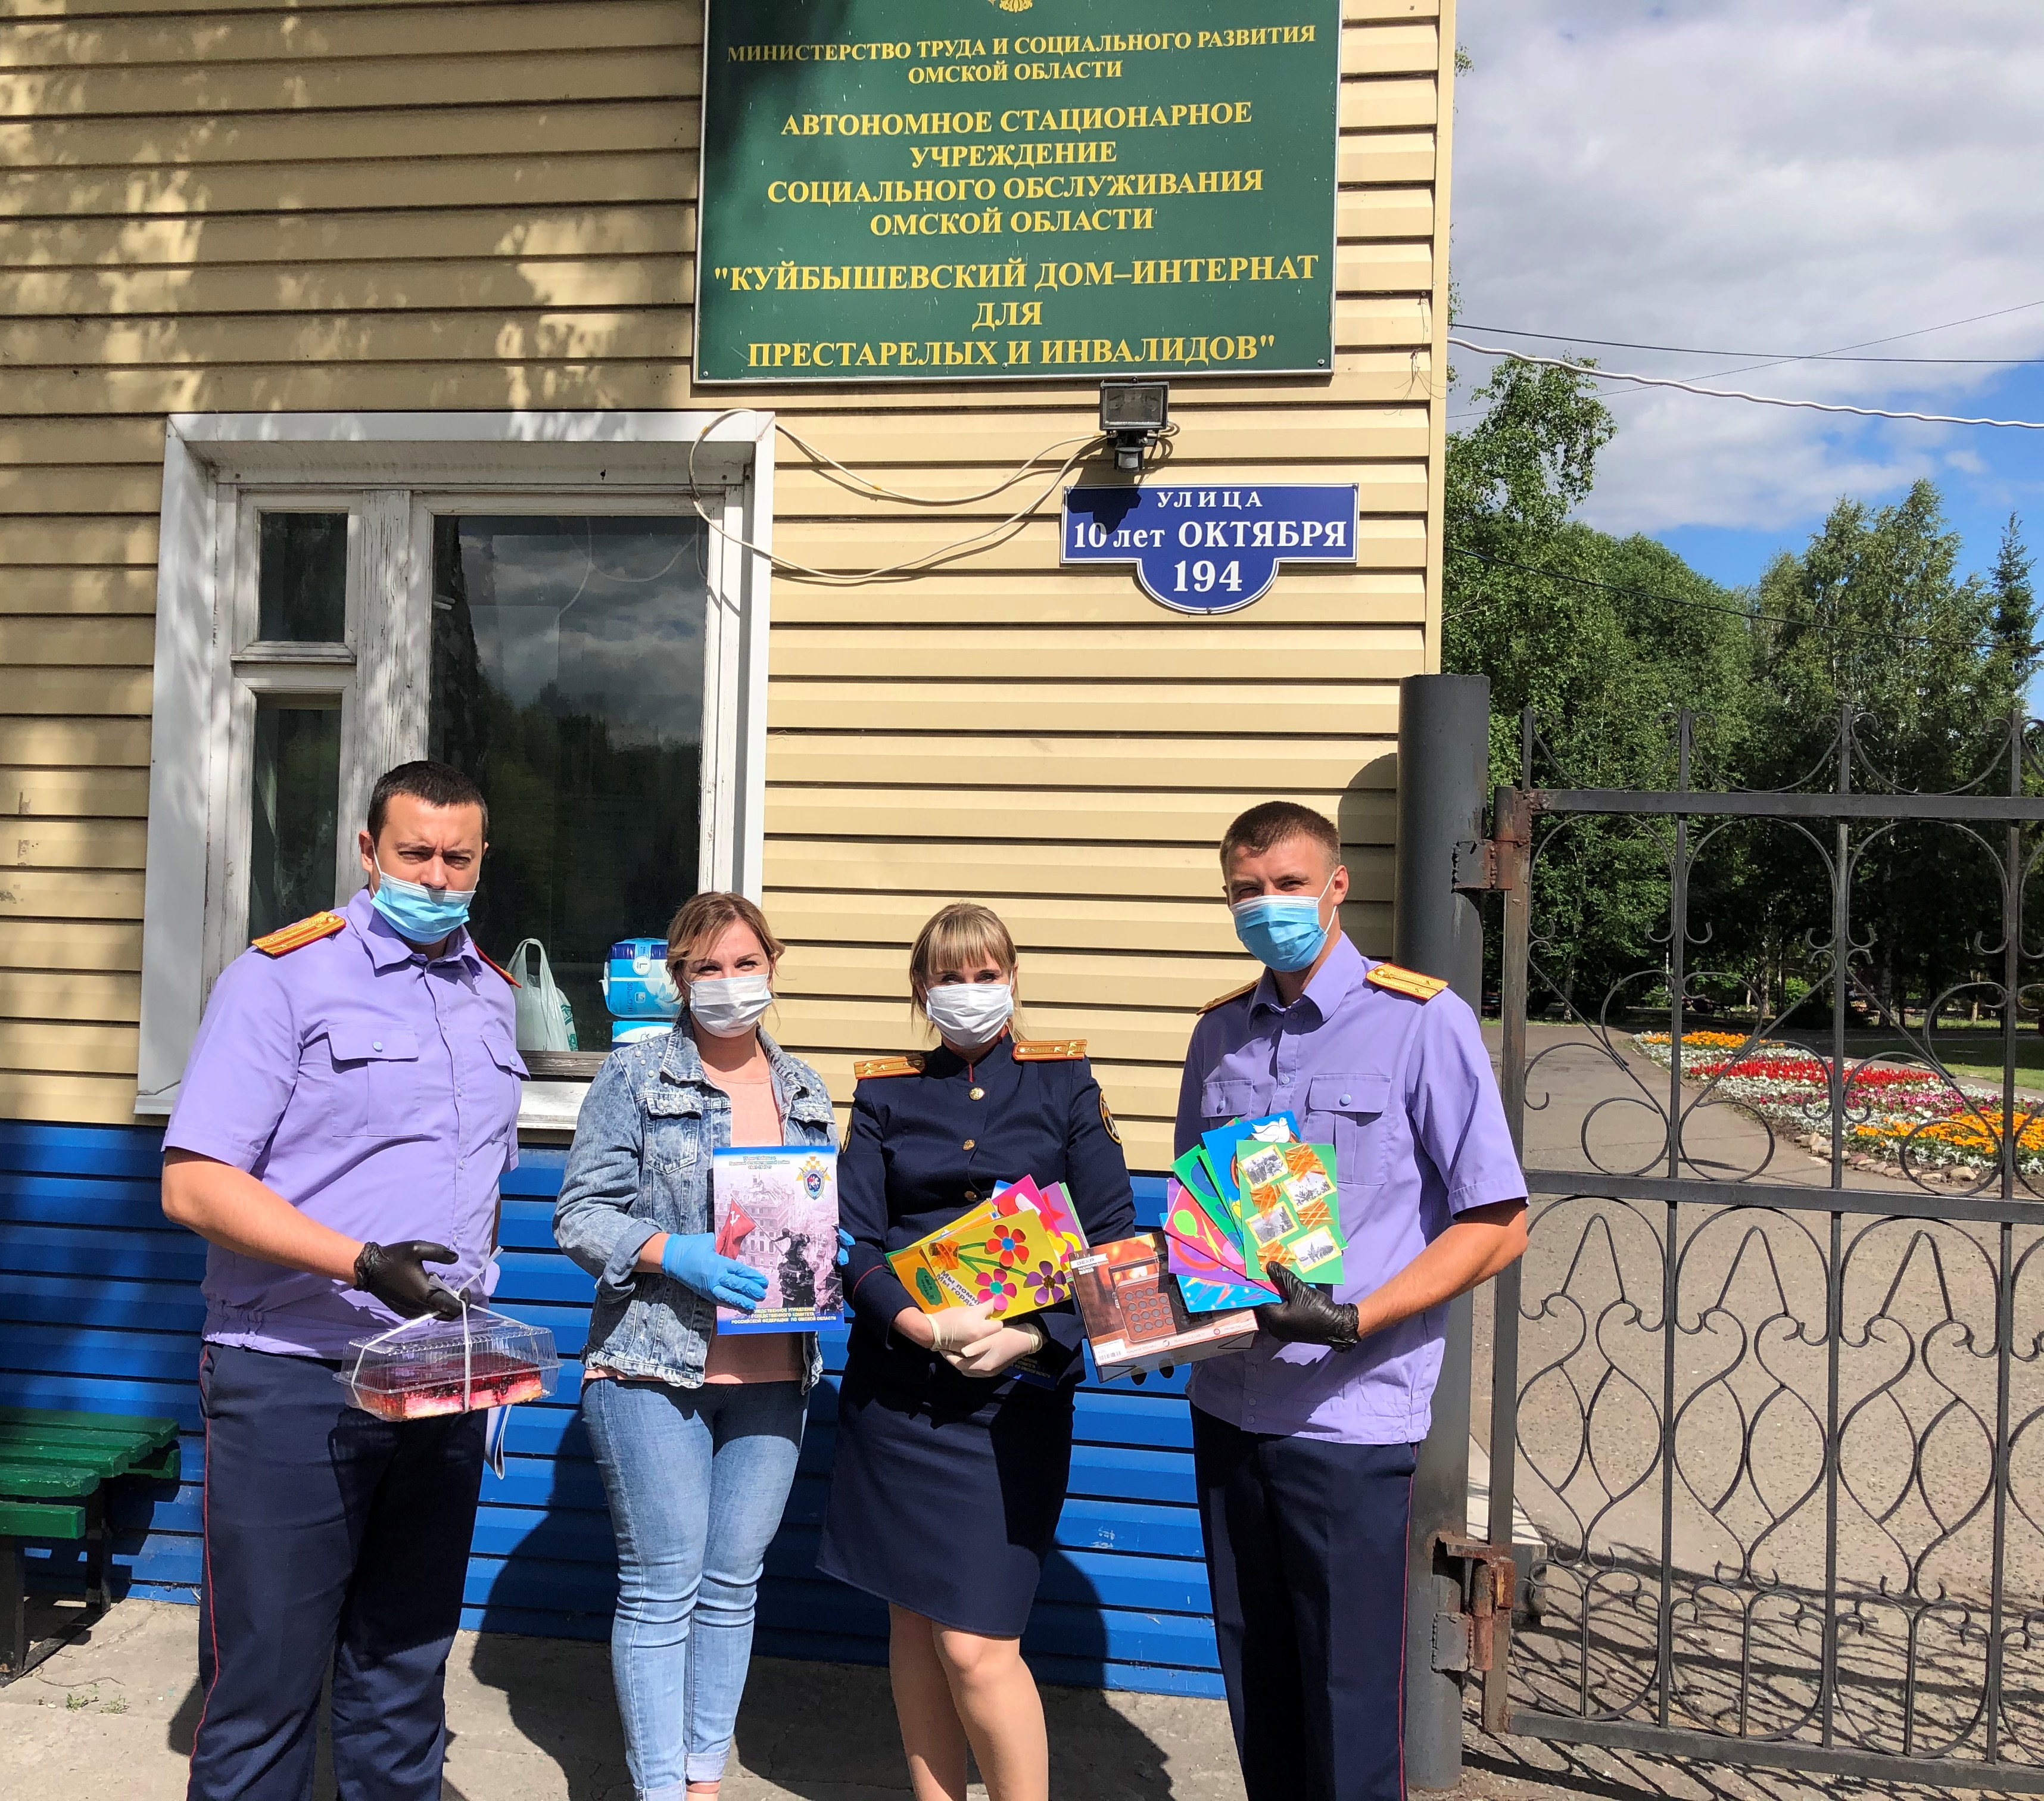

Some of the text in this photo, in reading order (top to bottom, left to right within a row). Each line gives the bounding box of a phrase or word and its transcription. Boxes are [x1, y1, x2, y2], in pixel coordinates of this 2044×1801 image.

[727, 24, 1315, 61] МИНИСТЕРСТВО ТРУДА И СОЦИАЛЬНОГО РАЗВИТИЯ
[908, 60, 1122, 84] ОМСКОЙ ОБЛАСТИ
[781, 101, 1252, 136] АВТОНОМНОЕ СТАЦИОНАРНОЕ
[909, 141, 1117, 169] УЧРЕЖДЕНИЕ
[767, 169, 1263, 205] СОЦИАЛЬНОГО ОБСЛУЖИВАНИЯ
[870, 207, 1153, 236] ОМСКОЙ ОБЛАСТИ
[715, 257, 1026, 291] "КУЙБЫШЕВСКИЙ
[971, 301, 1042, 330] ДЛЯ
[748, 335, 1275, 367] ПРЕСТАРЕЛЫХ И ИНВАЛИДОВ"
[1156, 491, 1263, 510] УЛИЦА
[1074, 521, 1347, 548] 10 лет ОКТЯБРЯ
[1173, 560, 1243, 593] 194
[936, 1274, 950, 1287] Мы
[940, 1270, 955, 1284] Мы
